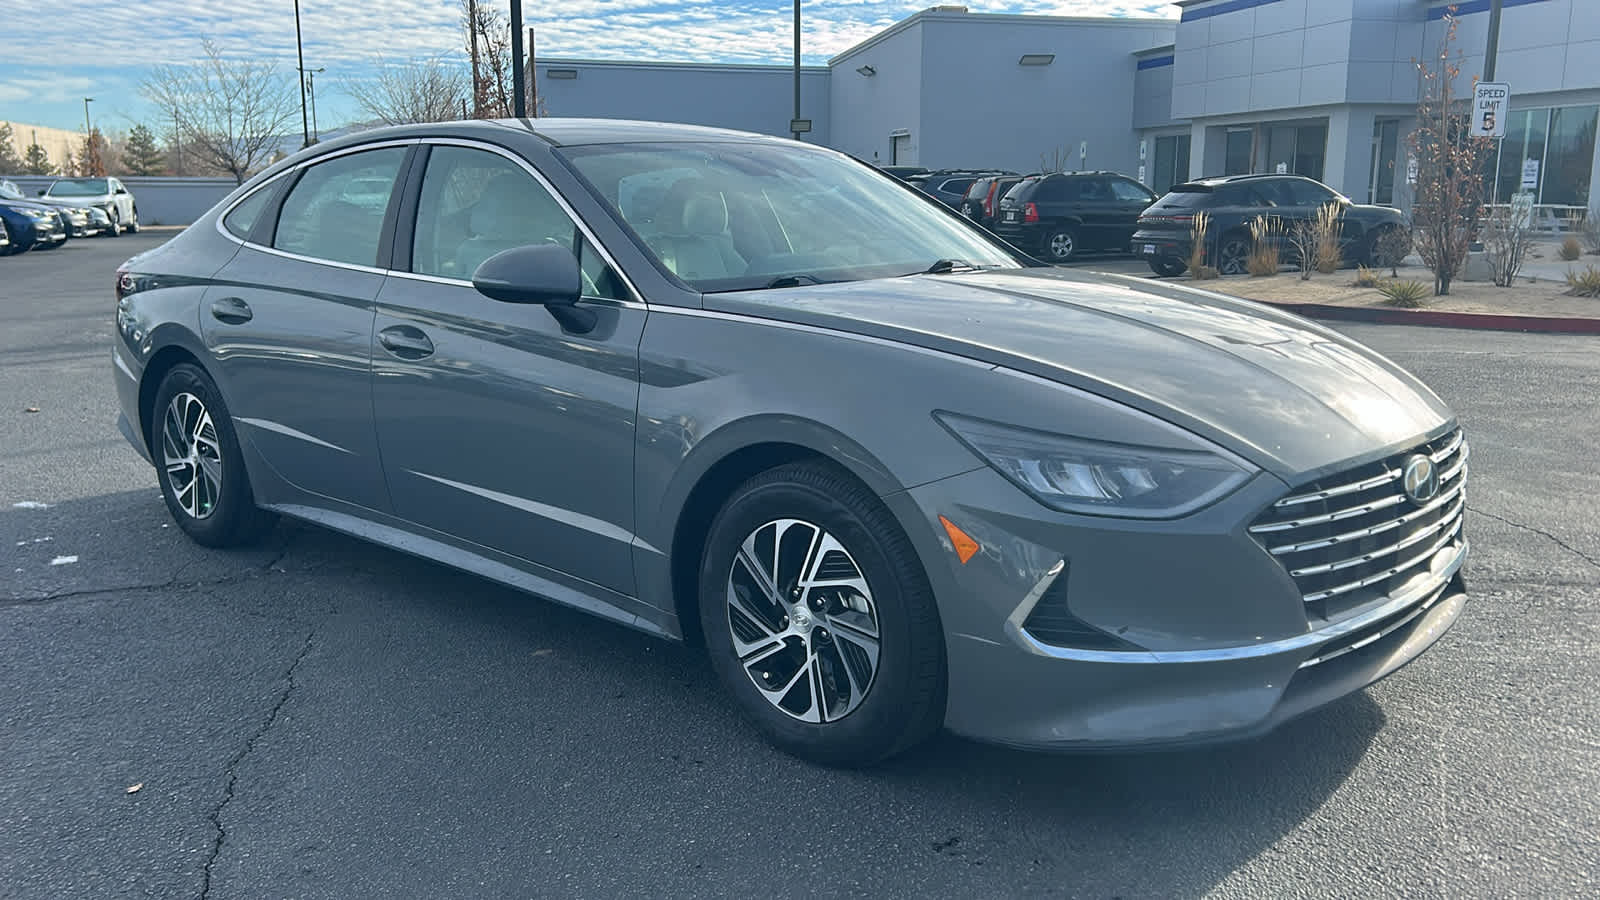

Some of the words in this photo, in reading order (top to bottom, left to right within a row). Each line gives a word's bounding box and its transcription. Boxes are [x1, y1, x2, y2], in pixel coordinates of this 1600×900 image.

[1478, 89, 1505, 98] SPEED
[1479, 100, 1501, 110] LIMIT
[1481, 112, 1496, 131] 5
